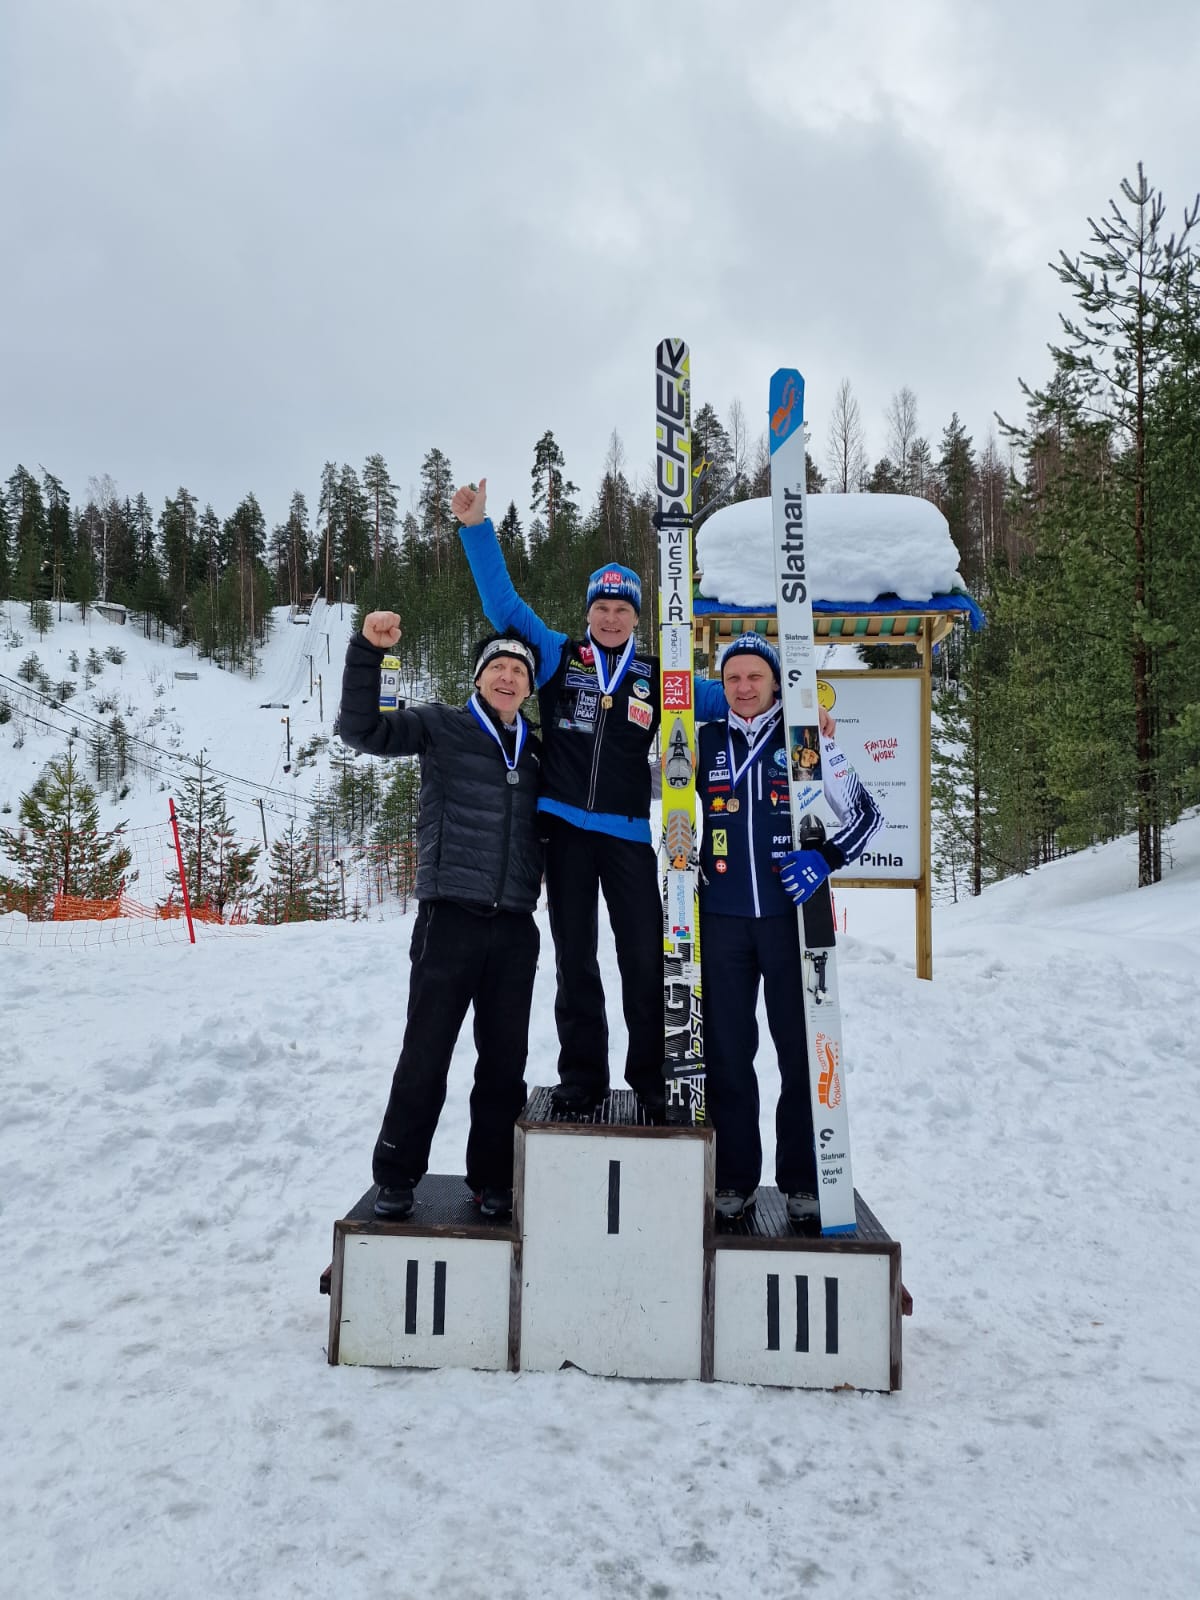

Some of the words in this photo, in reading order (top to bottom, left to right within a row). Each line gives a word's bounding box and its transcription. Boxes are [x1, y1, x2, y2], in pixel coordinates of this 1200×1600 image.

[668, 532, 683, 622] MESTAR
[863, 737, 898, 755] FANTASIA
[872, 750, 896, 763] WORKS
[860, 850, 904, 867] Pihla
[690, 993, 705, 1108] FISCER
[821, 1167, 843, 1177] World
[822, 1177, 838, 1186] Cup
